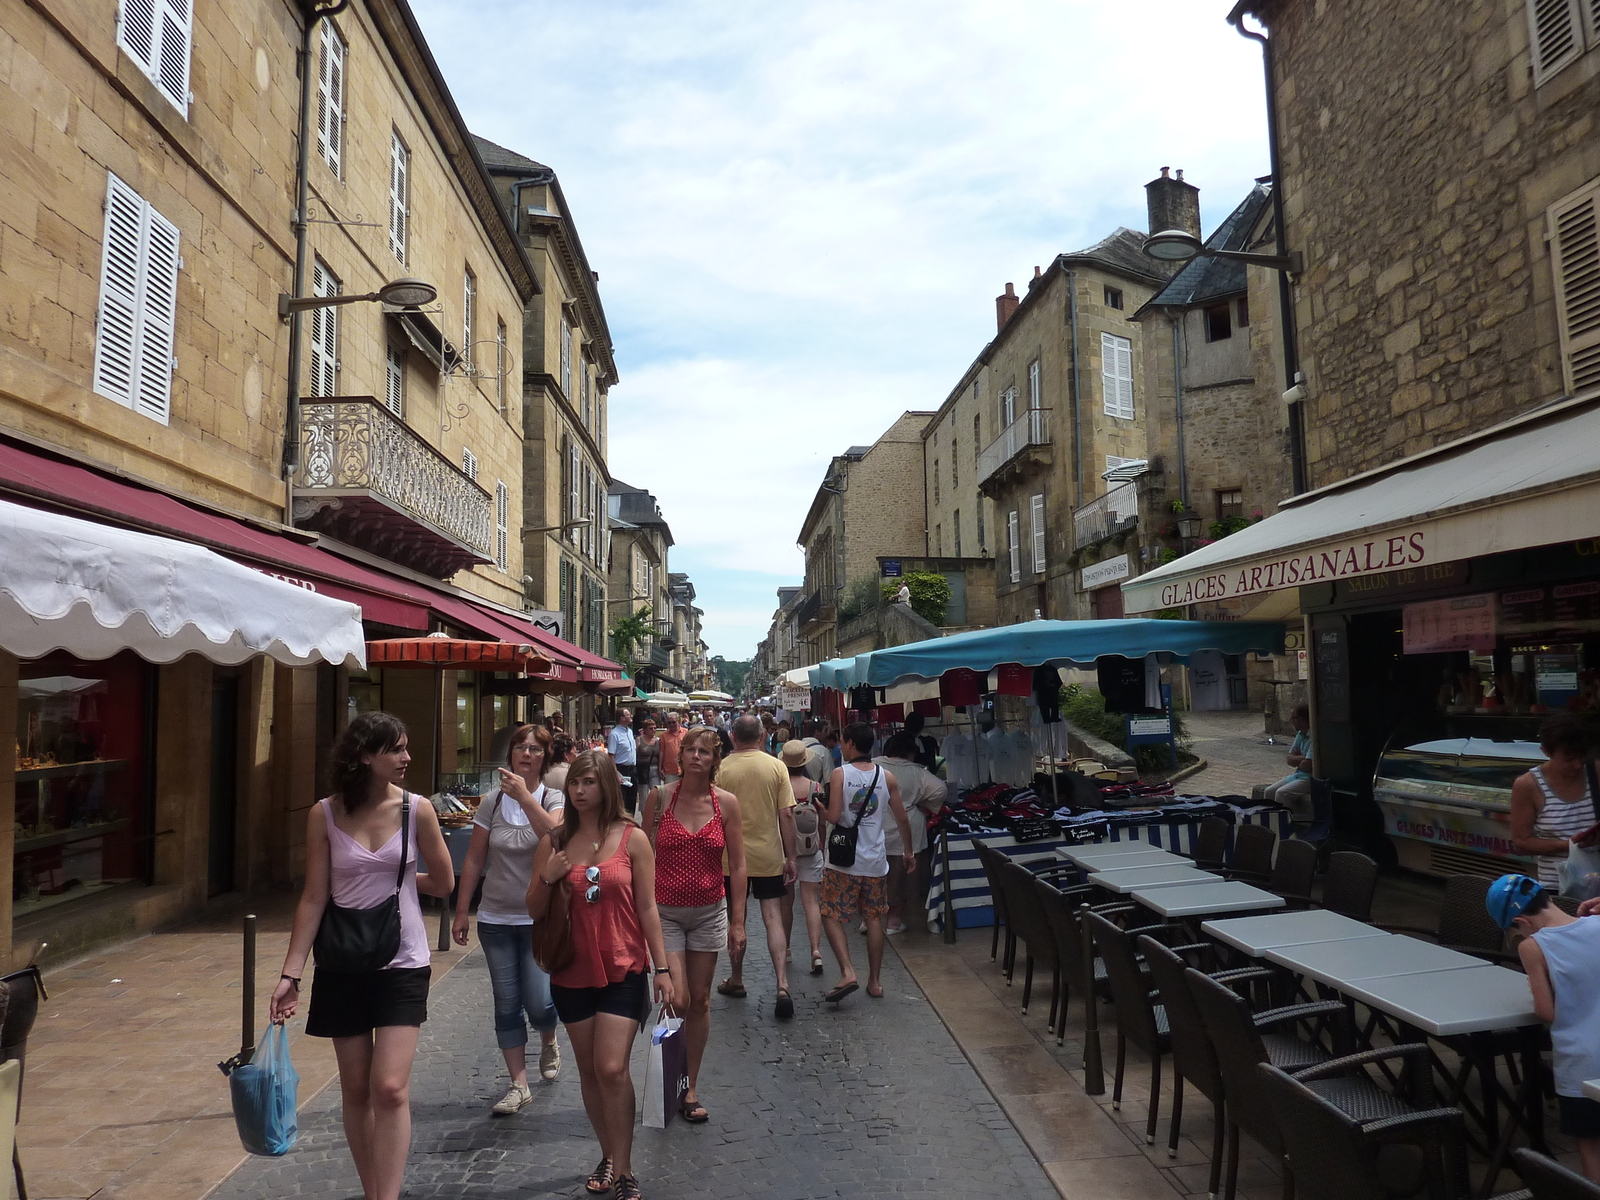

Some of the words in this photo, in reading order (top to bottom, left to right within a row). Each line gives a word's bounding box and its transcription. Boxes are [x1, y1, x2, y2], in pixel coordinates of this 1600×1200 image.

[1161, 574, 1226, 606] GLACES
[1235, 532, 1425, 594] ARTISANALES
[1348, 574, 1389, 592] SALON
[1397, 569, 1416, 585] DE
[1556, 583, 1597, 595] GAUFRES
[987, 701, 994, 710] P
[1396, 820, 1435, 840] GLACES
